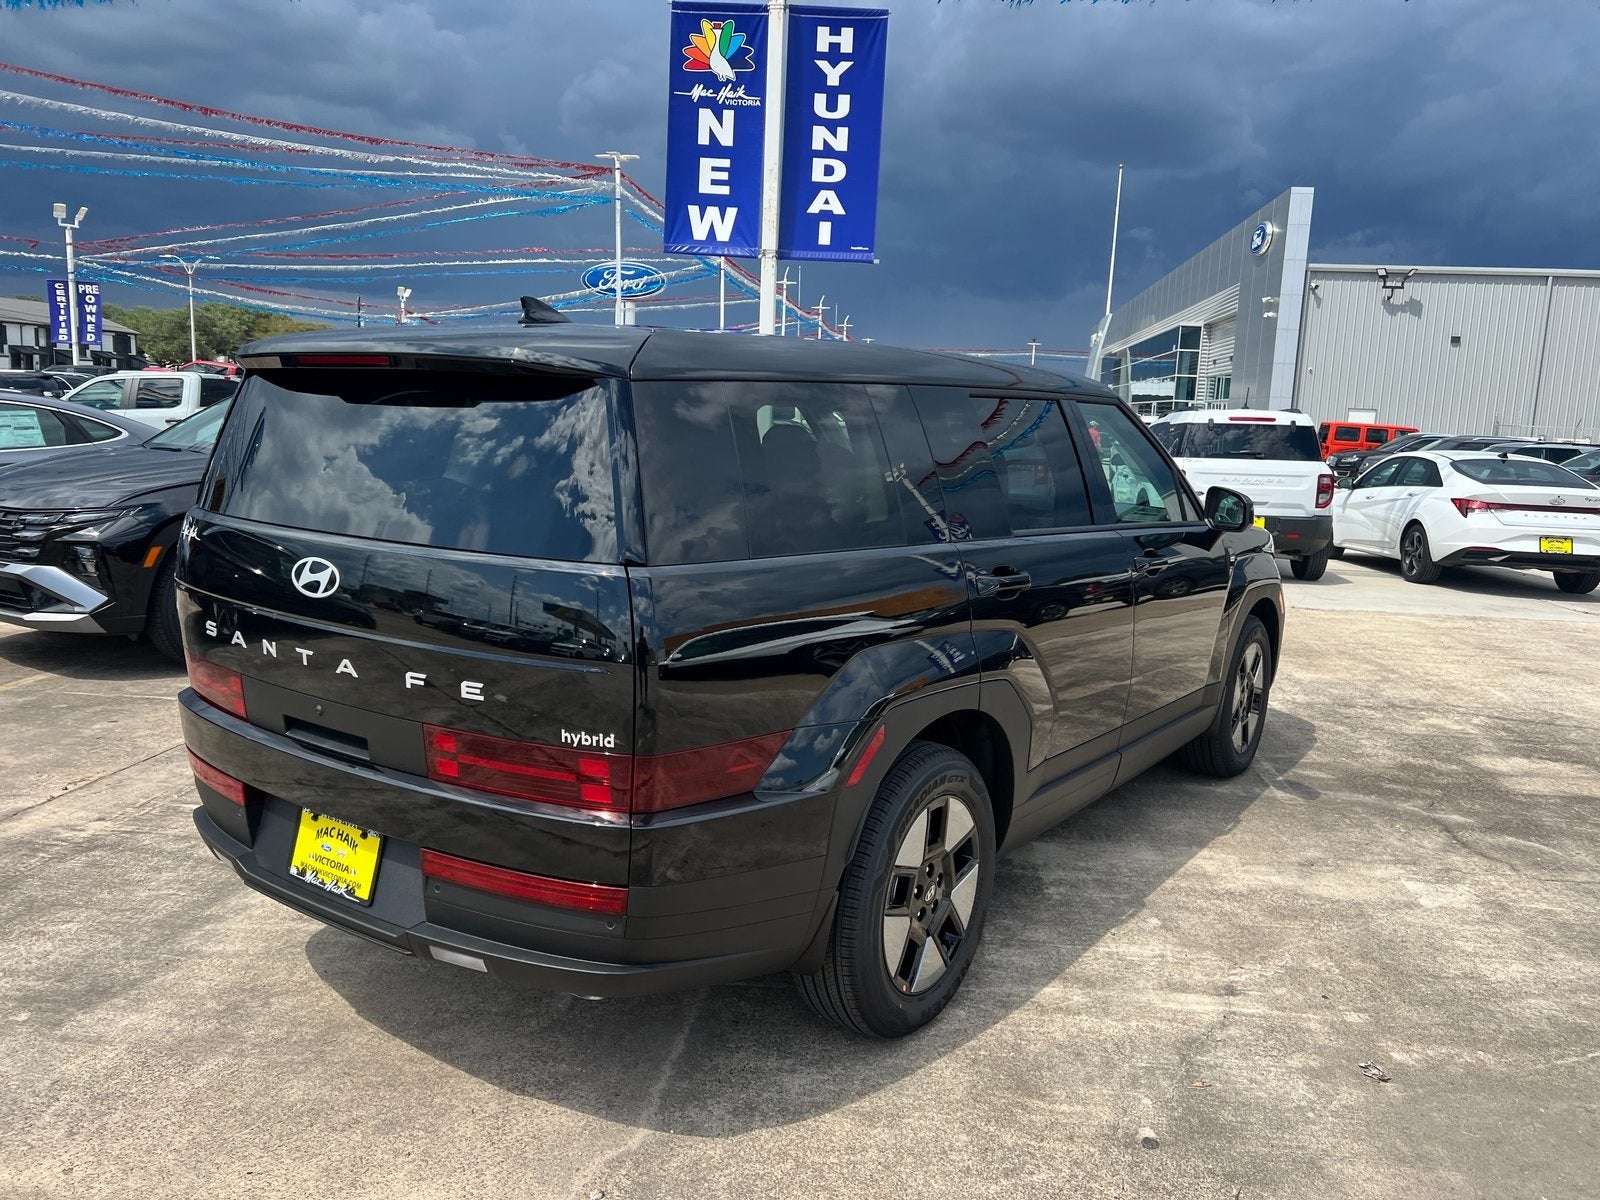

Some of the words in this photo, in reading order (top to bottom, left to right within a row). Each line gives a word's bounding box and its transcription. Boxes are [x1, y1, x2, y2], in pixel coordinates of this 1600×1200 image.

[674, 83, 717, 103] Mac
[716, 83, 761, 104] Haik
[806, 26, 854, 246] HYUNDAI
[687, 107, 738, 242] NEW
[78, 284, 99, 294] PRE
[54, 283, 68, 341] CERTIFIED
[84, 295, 97, 342] OWNED
[205, 619, 359, 678] SANTA
[405, 671, 486, 701] FE
[561, 728, 615, 748] hybrid
[315, 826, 335, 840] MAC
[336, 828, 359, 855] HAIK
[314, 853, 349, 875] VICTORIA
[323, 879, 360, 902] Haik
